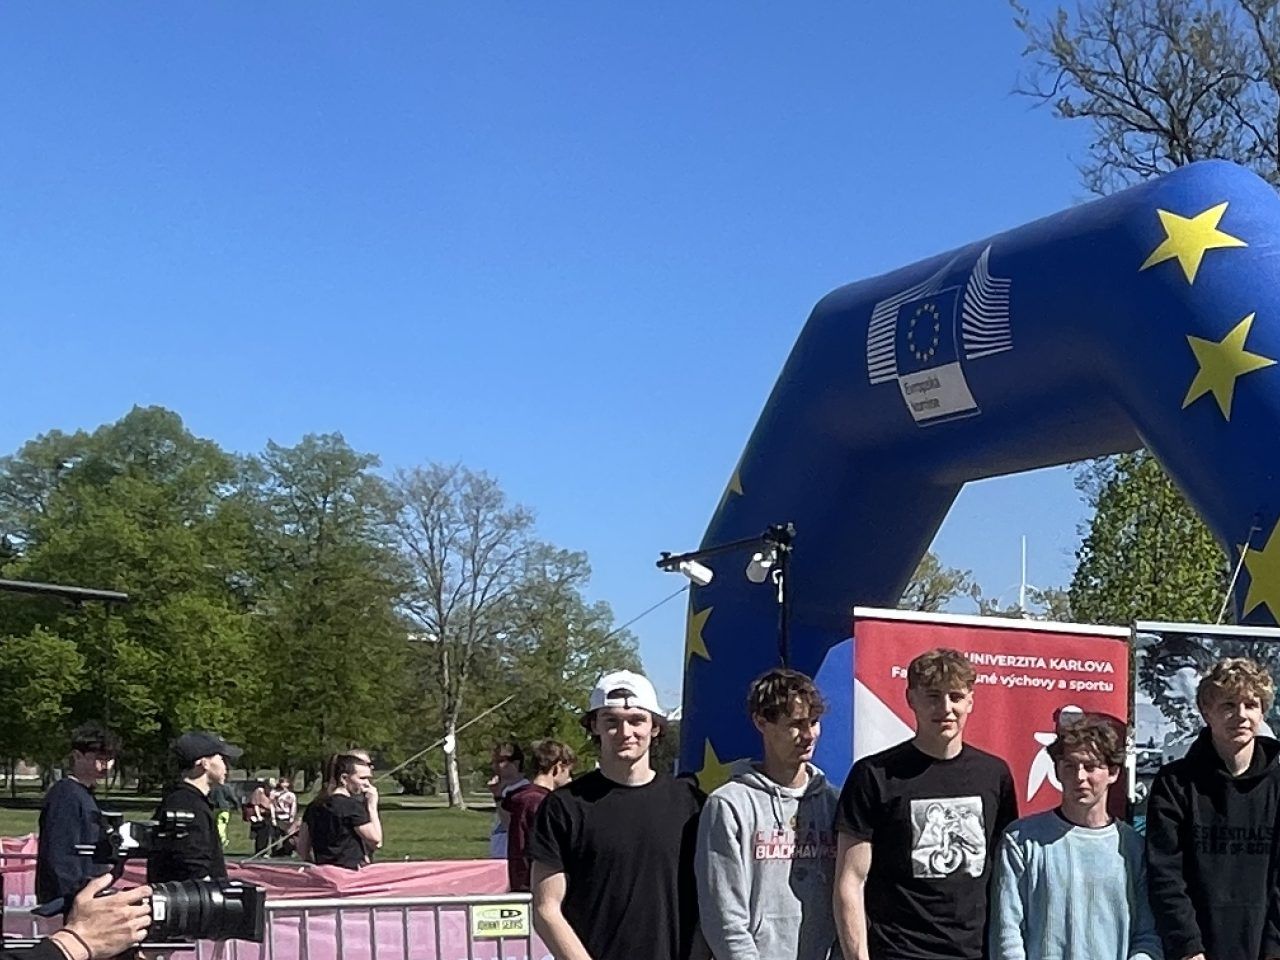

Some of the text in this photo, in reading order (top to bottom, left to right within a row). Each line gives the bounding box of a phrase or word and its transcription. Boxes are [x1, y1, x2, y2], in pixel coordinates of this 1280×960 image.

[1050, 659, 1115, 673] KARLOVA
[1000, 674, 1056, 690] výchovy
[1058, 680, 1067, 689] a
[1070, 679, 1114, 693] sportu
